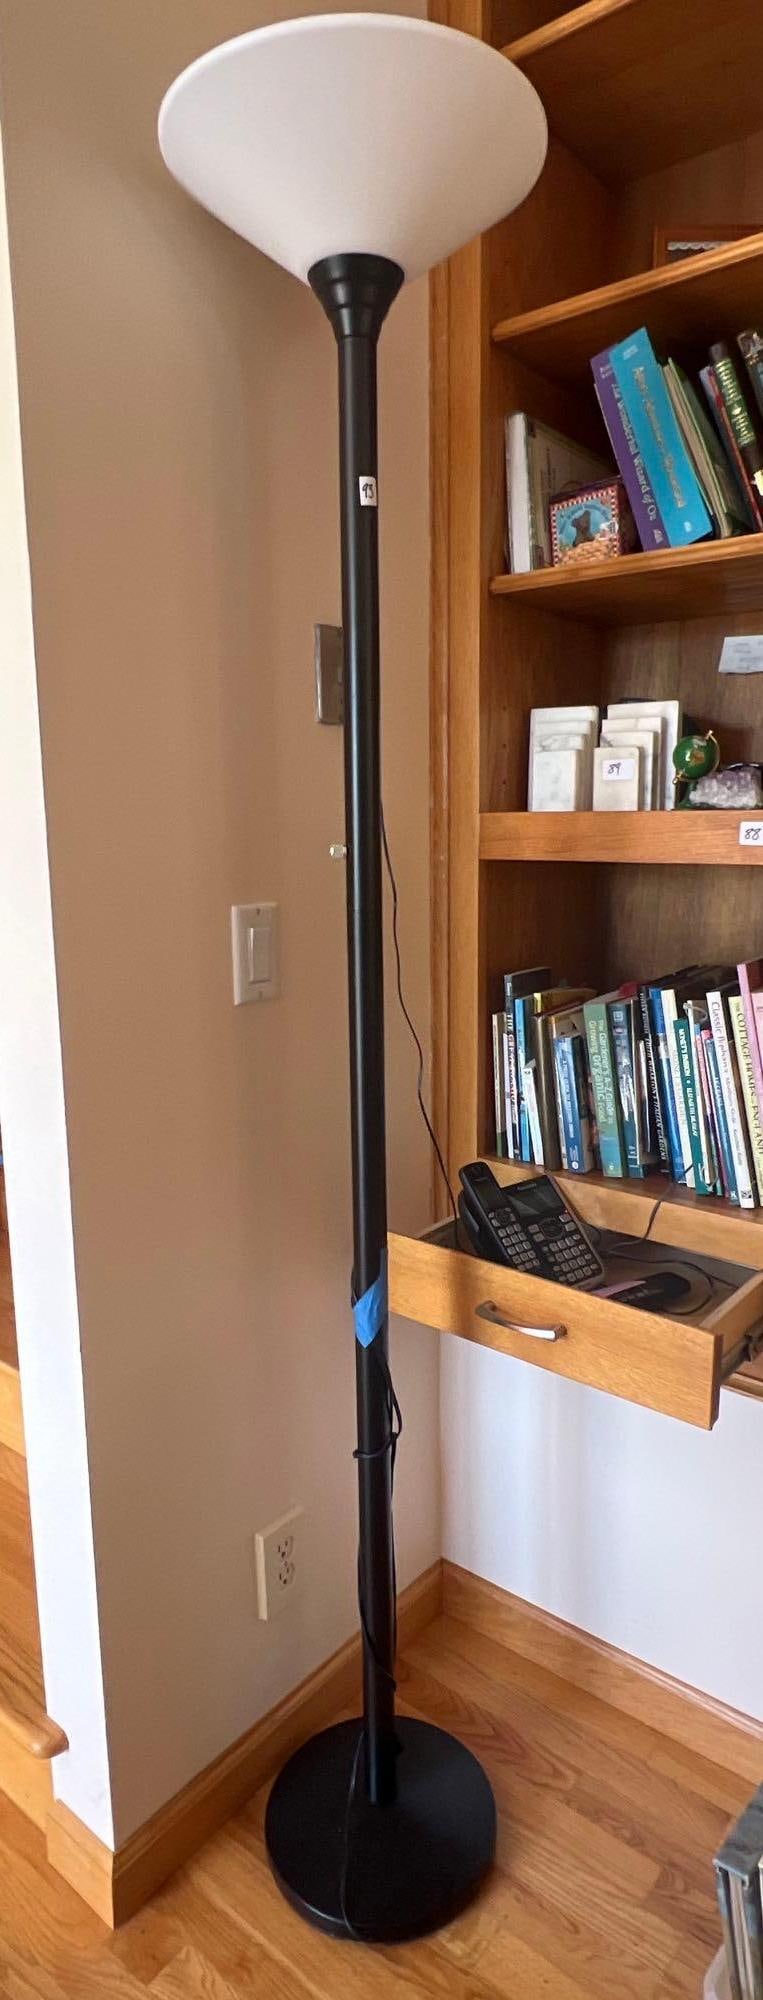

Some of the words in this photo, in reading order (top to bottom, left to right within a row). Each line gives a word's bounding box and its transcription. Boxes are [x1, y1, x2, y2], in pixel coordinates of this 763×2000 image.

[634, 454, 650, 494] Wizard
[608, 762, 621, 776] 89
[744, 828, 762, 841] 88
[712, 1001, 723, 1033] Classic
[737, 1012, 751, 1058] COTTAGE
[746, 1063, 757, 1097] HOMES
